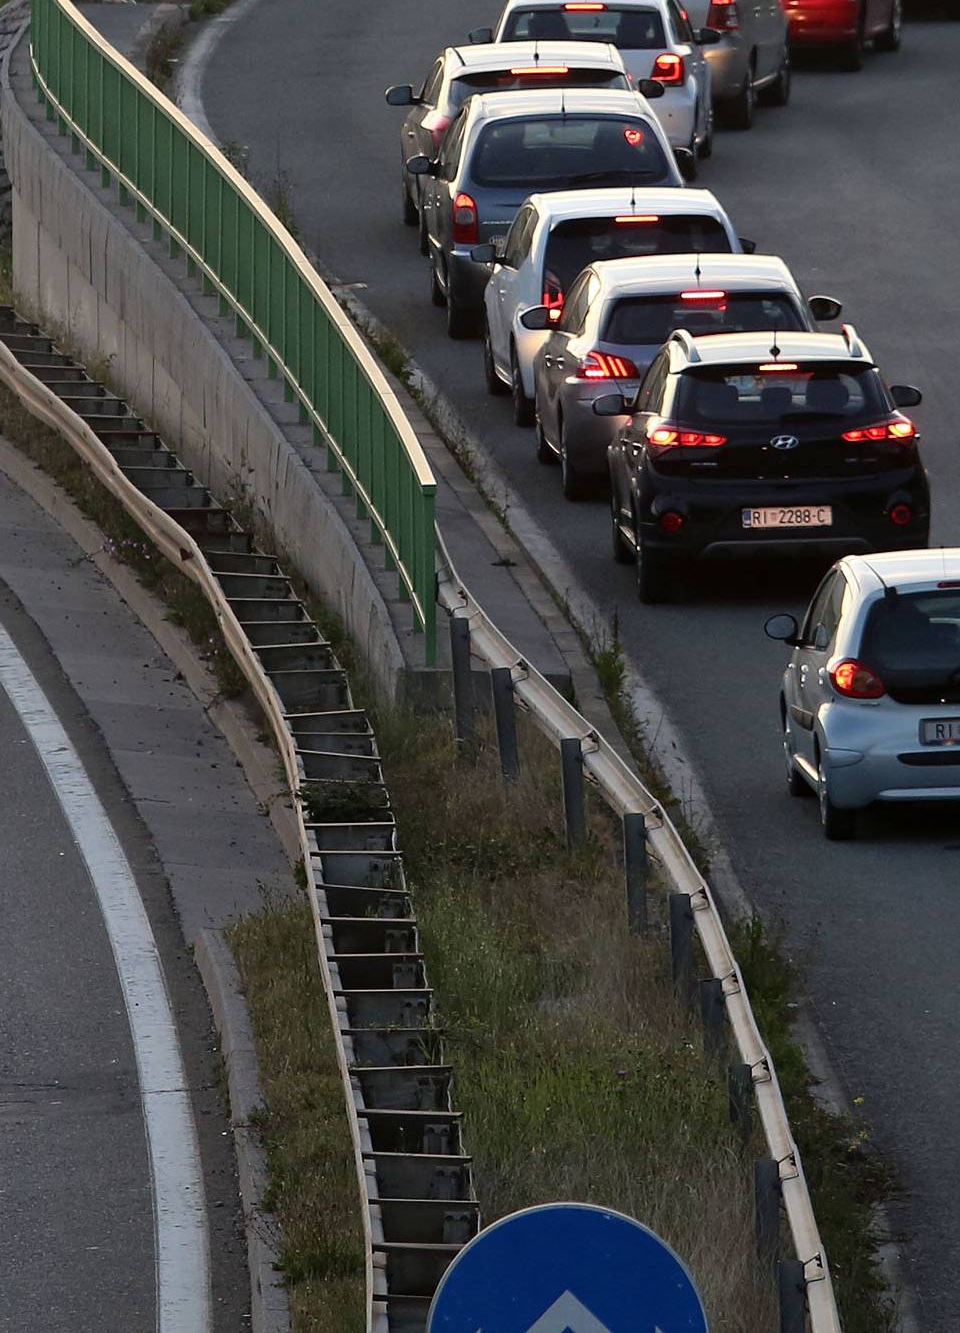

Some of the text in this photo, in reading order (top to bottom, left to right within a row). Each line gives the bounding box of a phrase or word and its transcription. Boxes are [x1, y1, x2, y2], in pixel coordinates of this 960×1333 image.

[752, 509, 825, 525] RI 2288-C
[935, 723, 952, 739] RI
